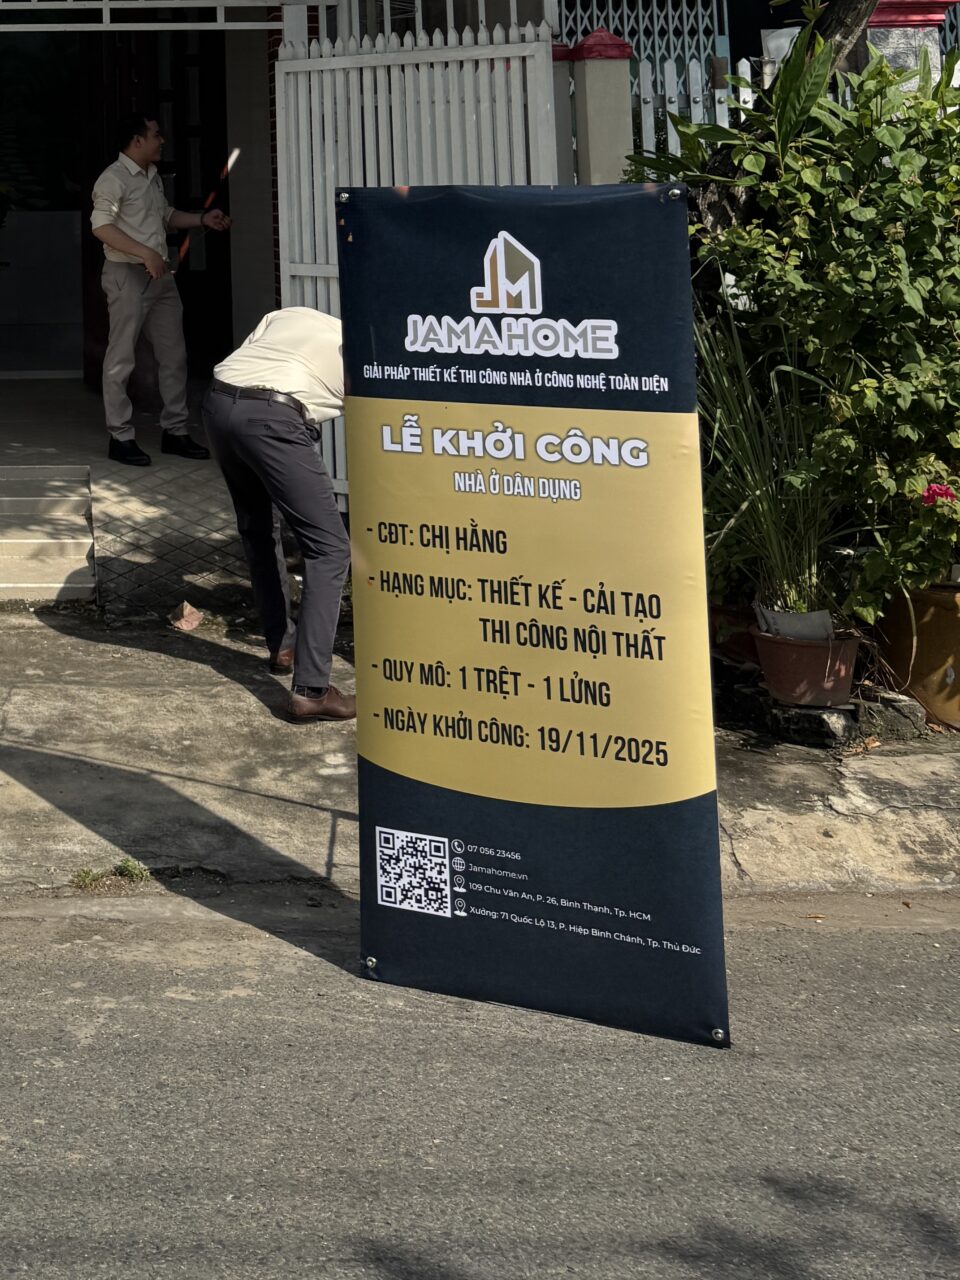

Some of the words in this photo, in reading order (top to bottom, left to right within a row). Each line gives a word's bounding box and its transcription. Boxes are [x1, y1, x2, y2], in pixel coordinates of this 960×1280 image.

[363, 362, 382, 378] GIẢI
[384, 364, 410, 380] PHÁP
[412, 365, 441, 382] THIẾT
[444, 366, 459, 382] KẾ
[460, 370, 476, 384] THI
[480, 368, 507, 384] CÔNG
[510, 370, 532, 386] NHÀ
[534, 368, 542, 386] Ở
[544, 371, 574, 388] CÔNG
[576, 372, 606, 392] NGHỆ
[609, 374, 639, 390] TOÀN
[642, 374, 668, 394] DIỆN
[381, 414, 423, 454] LỄ
[433, 422, 525, 460] KHỞI
[536, 428, 649, 467] CÔNG
[454, 469, 486, 494] NHÀ
[489, 468, 500, 494] Ở
[504, 473, 534, 498] DÂN
[538, 478, 581, 503] DỤNG
[377, 522, 414, 547] CĐT:
[419, 524, 450, 554] CHỊ
[455, 518, 508, 554] HẰNG
[380, 570, 424, 599] HẠNG
[429, 576, 472, 604] MỤC:
[477, 574, 532, 607] THIẾT
[538, 579, 567, 610] KẾ
[583, 582, 615, 616] CẢI
[620, 592, 662, 623] TẠO
[479, 618, 510, 645] THI
[516, 618, 568, 651] CÔNG
[574, 624, 606, 660] NỘI
[612, 628, 666, 661] THẤT
[382, 658, 414, 684] QUY
[420, 660, 451, 688] MÔ:
[459, 666, 468, 690] 1
[473, 666, 522, 700] TRỆT
[543, 676, 552, 700] 1
[559, 671, 611, 708] LỬNG
[384, 706, 428, 736] NGÀY
[432, 710, 472, 741] KHỞI
[478, 716, 530, 749] CÔNG:
[537, 726, 668, 768] 19/11/2025
[468, 844, 478, 852] 07
[480, 846, 494, 856] 056
[496, 849, 521, 860] 23456
[468, 863, 528, 880] Jamahome.vn
[468, 882, 482, 891] 109
[484, 885, 500, 894] Chu
[521, 892, 535, 902] An,
[536, 894, 545, 903] P.
[546, 896, 559, 906] 26,
[614, 908, 628, 918] Tp.
[629, 910, 651, 921] HCM
[500, 911, 508, 920] 71
[510, 914, 533, 925] Quốc
[547, 920, 557, 930] 13,
[558, 922, 567, 932] P.
[568, 924, 589, 936] Hiệp
[647, 938, 660, 948] Tp.
[682, 944, 702, 954] Đức
